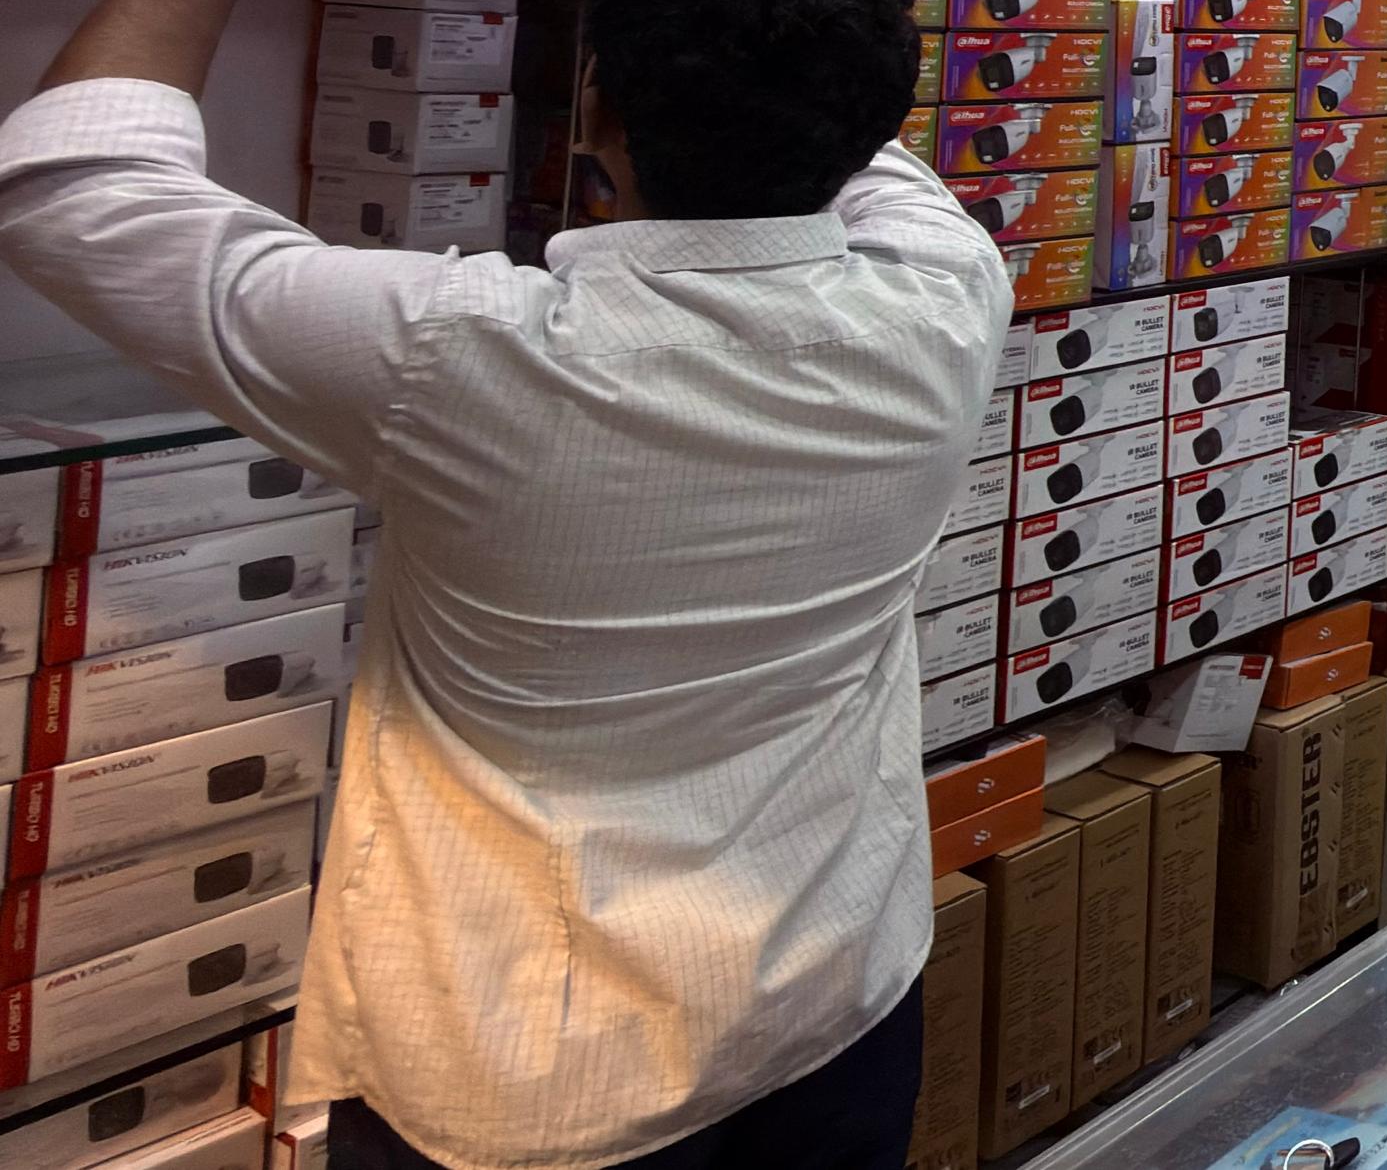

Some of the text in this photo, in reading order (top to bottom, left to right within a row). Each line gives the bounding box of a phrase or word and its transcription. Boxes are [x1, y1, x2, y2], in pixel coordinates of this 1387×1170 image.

[1266, 295, 1285, 303] BULLET
[1142, 316, 1164, 326] BULLET
[978, 478, 1004, 490] BULLET
[104, 548, 190, 569] HIKVISION
[971, 548, 997, 561] BULLET
